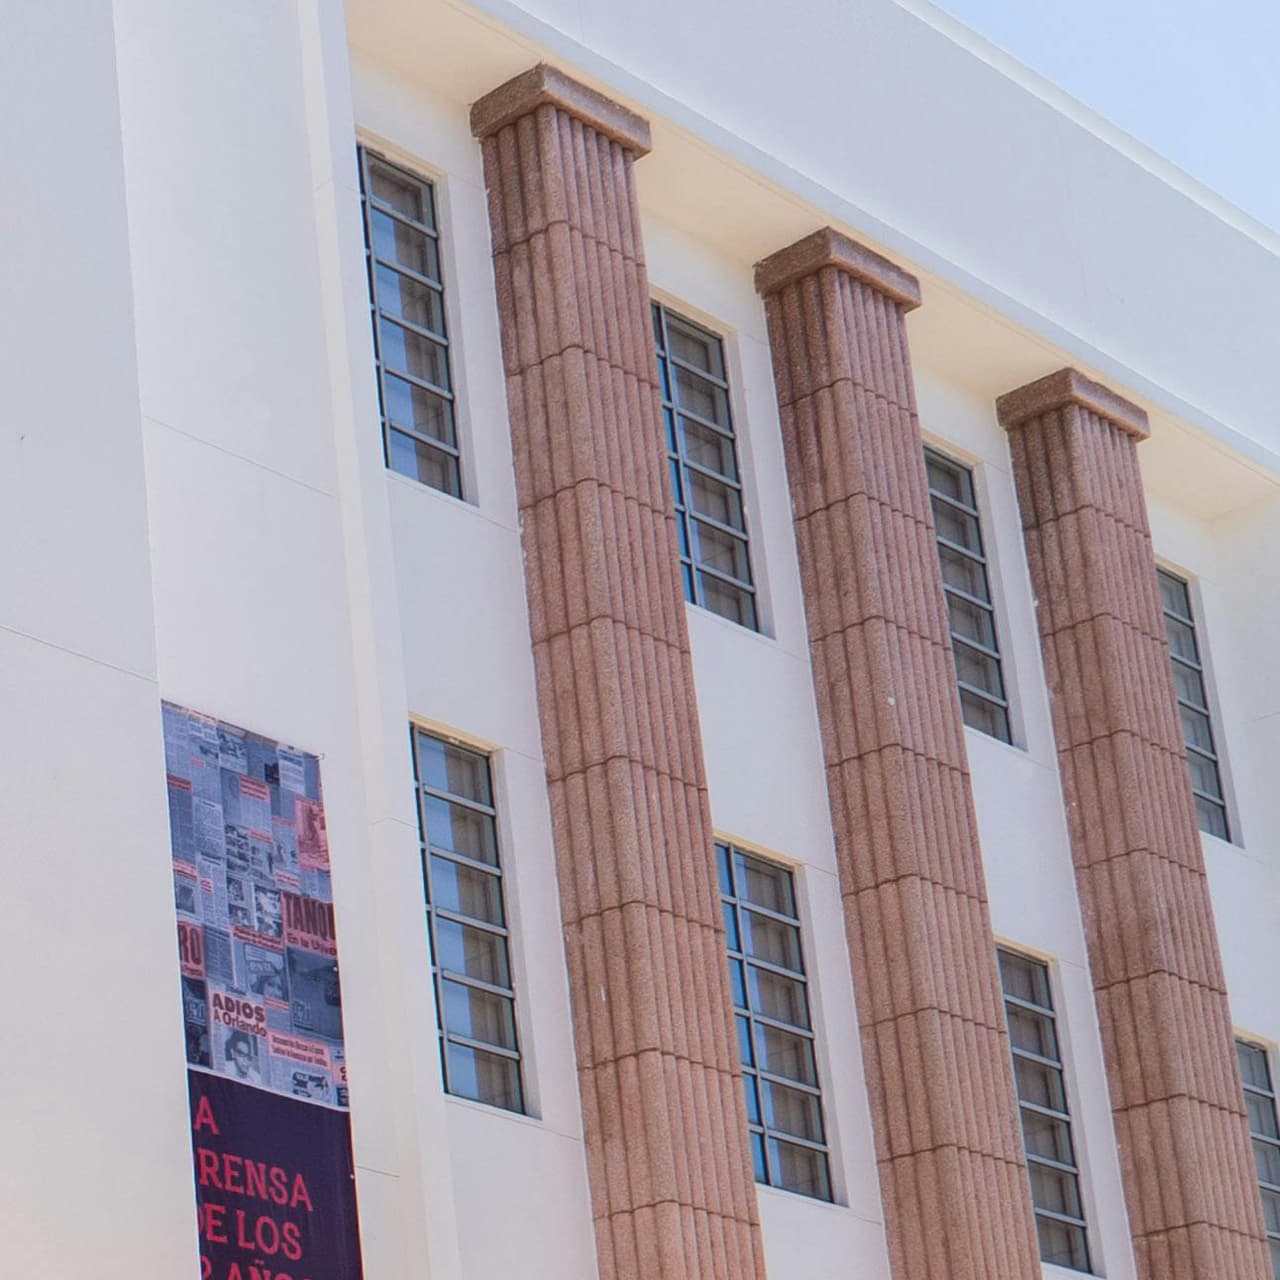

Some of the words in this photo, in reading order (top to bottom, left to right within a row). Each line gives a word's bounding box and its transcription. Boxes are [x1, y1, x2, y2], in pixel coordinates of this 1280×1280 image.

[212, 993, 266, 1023] ADIOS
[223, 1011, 267, 1038] Orlando
[193, 1095, 220, 1135] A
[197, 1147, 314, 1213] RENSA
[198, 1202, 228, 1244] E
[236, 1209, 303, 1261] LOS
